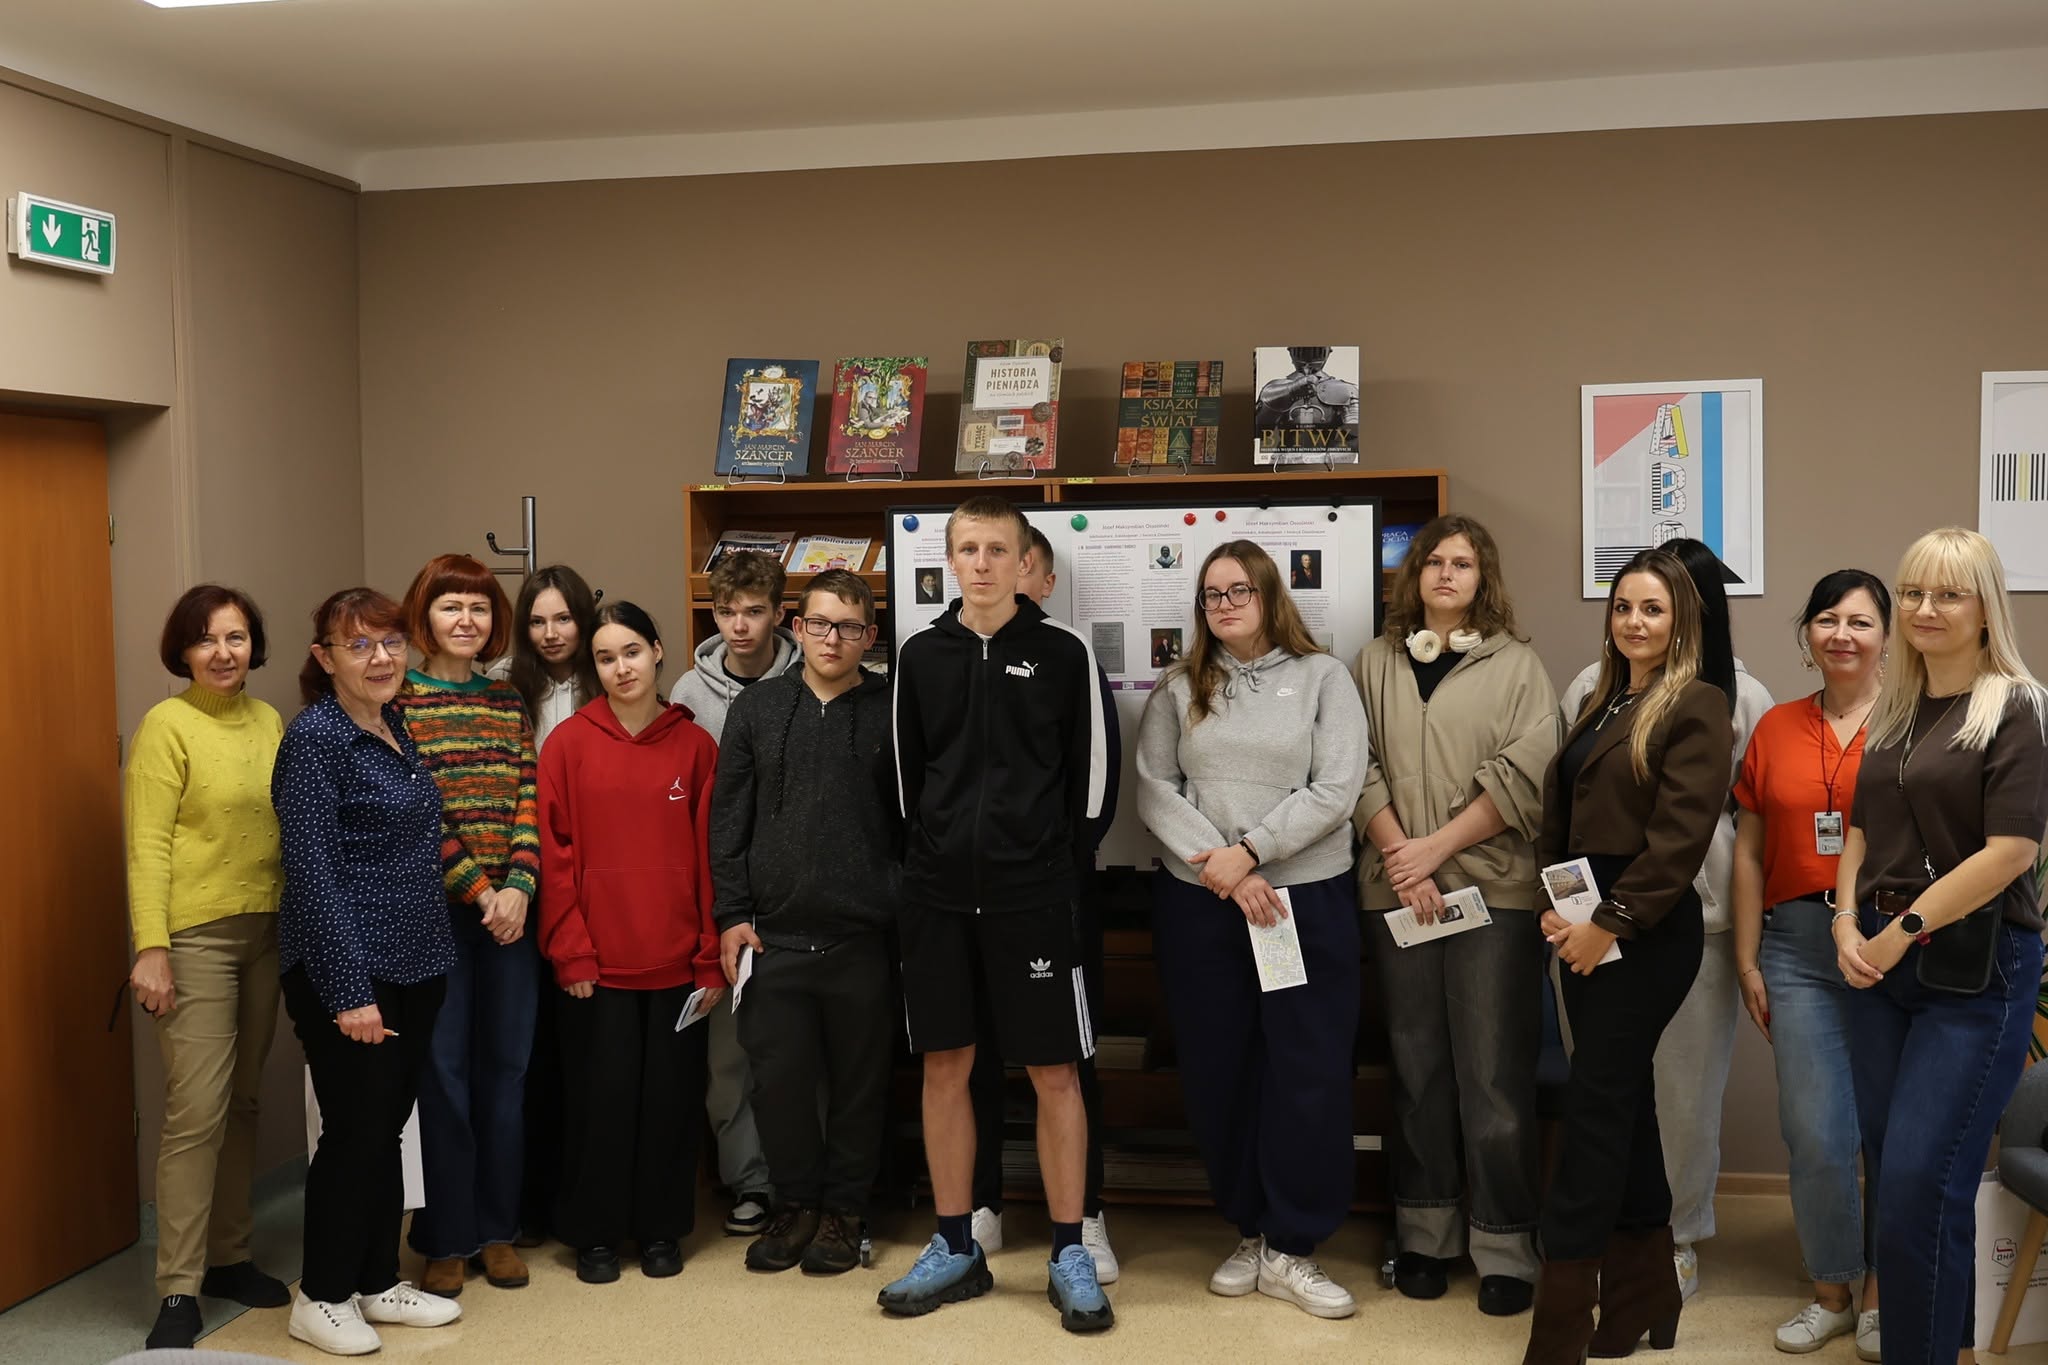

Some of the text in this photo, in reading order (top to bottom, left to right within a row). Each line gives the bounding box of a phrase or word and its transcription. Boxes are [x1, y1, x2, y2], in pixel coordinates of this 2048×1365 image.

[991, 367, 1037, 378] HISTORIA
[986, 379, 1040, 392] PIENIĄDZA
[1141, 413, 1198, 427] ŚWIAT
[1262, 429, 1351, 447] BITWY
[735, 450, 793, 461] SZANCER
[845, 447, 905, 458] SZANCER
[1005, 664, 1031, 679] PUMA
[1029, 971, 1054, 979] adidas
